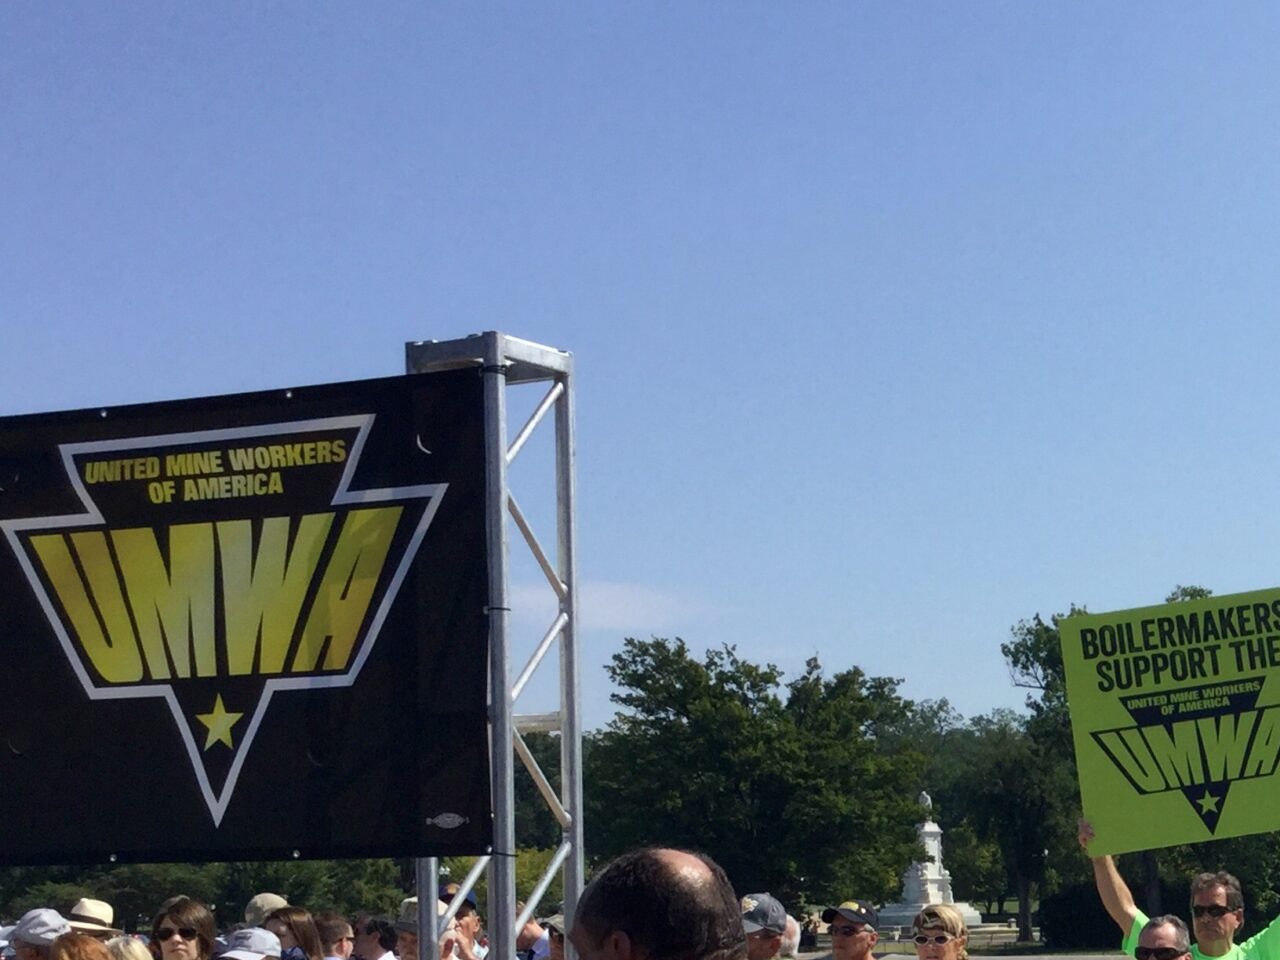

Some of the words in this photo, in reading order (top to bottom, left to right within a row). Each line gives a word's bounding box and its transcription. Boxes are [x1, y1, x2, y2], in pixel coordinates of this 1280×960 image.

[85, 456, 160, 484] UNITED
[165, 450, 222, 477] MINE
[228, 440, 346, 470] WORKERS
[148, 481, 176, 504] OF
[184, 472, 284, 502] AMERICA
[30, 506, 404, 683] UMWA
[1096, 645, 1221, 692] SUPPORT
[1127, 694, 1167, 710] UNITED
[1170, 690, 1199, 704] MINE
[1202, 681, 1262, 698] WORKERS
[1160, 703, 1175, 716] OF
[1178, 697, 1231, 713] AMERICA
